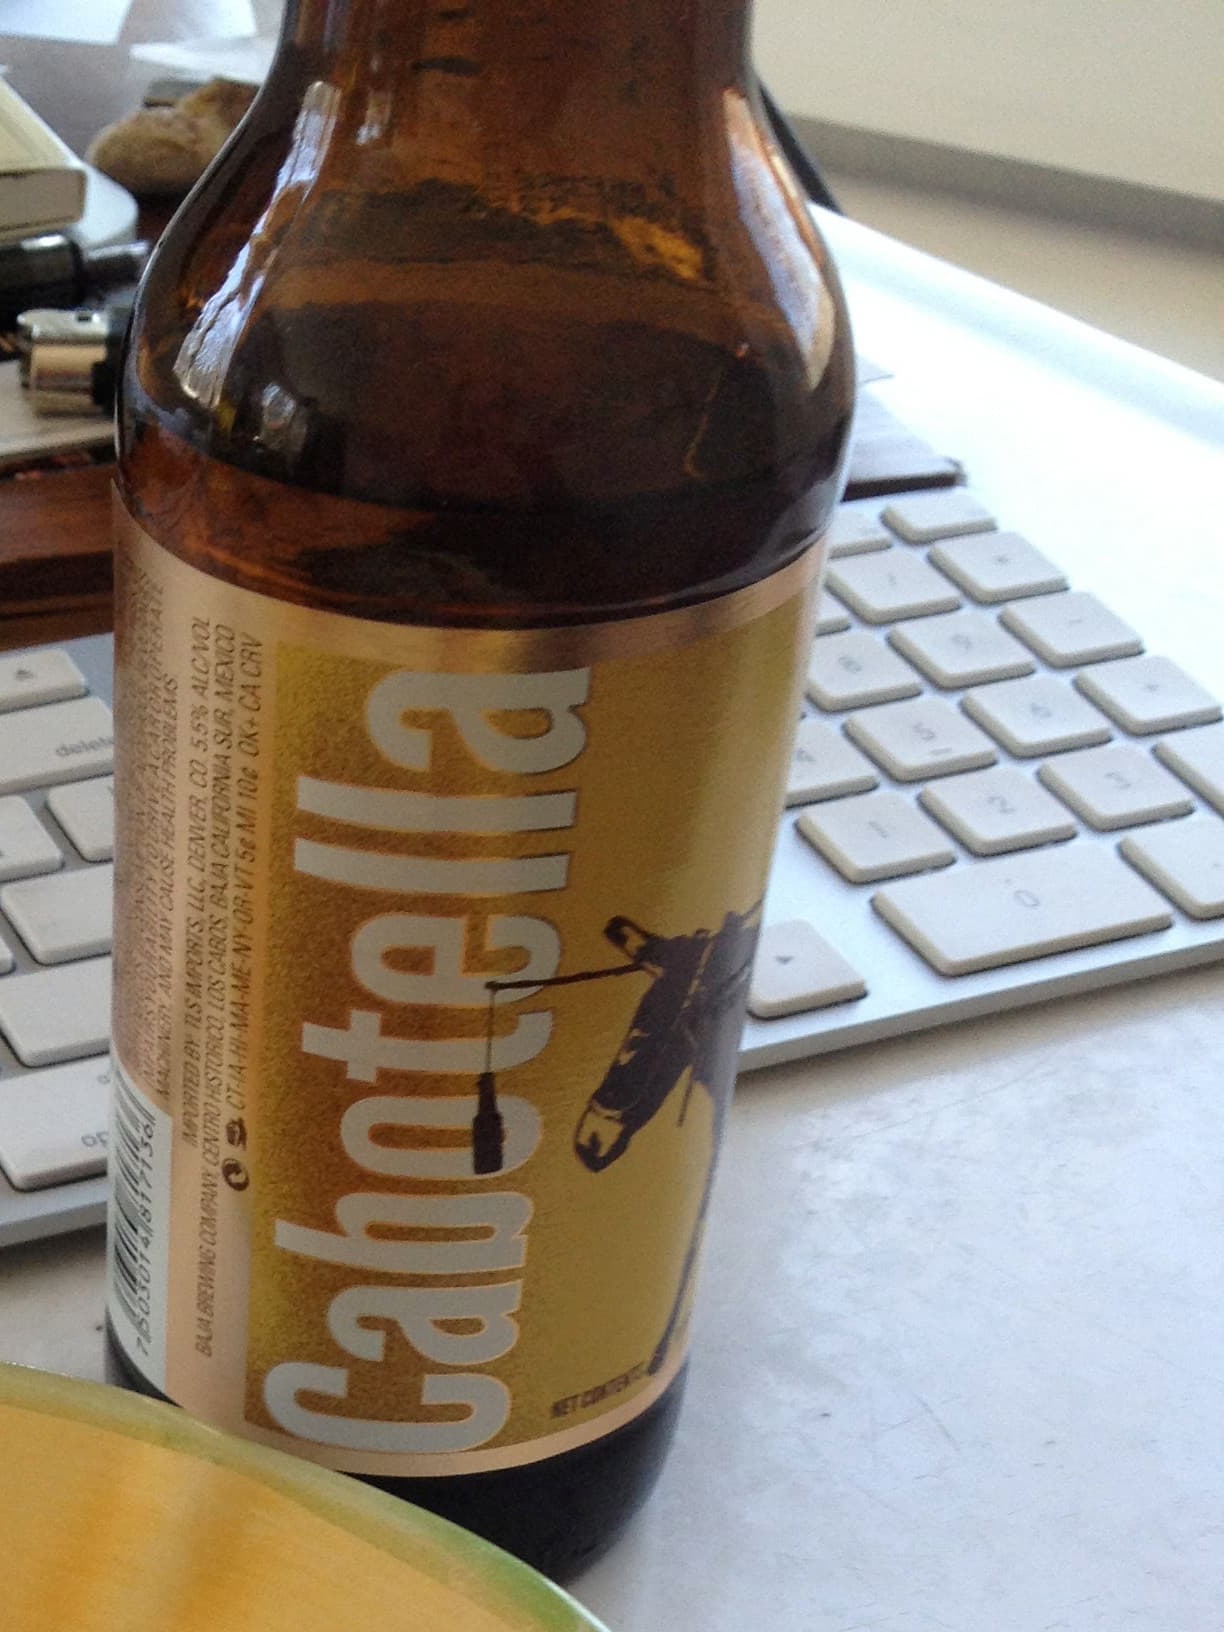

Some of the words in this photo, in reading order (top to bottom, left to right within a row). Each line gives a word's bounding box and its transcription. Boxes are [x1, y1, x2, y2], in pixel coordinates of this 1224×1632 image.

[190, 616, 211, 699] ALC/VOL
[213, 622, 235, 702] MEXICO
[239, 631, 263, 678] CRV
[239, 683, 262, 712] CA
[190, 703, 210, 751] 5.5%
[911, 722, 937, 742] 5
[159, 779, 176, 854] HEALTH
[210, 752, 231, 859] CALIFORNIA
[235, 805, 256, 833] MI
[986, 795, 1016, 815] 2
[159, 856, 175, 912] CAUSE
[209, 861, 228, 909] BAJA
[205, 974, 225, 1010] LOS
[262, 665, 592, 1454] Cabotella
[182, 1059, 200, 1146] IMPORTED
[202, 1101, 221, 1166] CENTRO
[196, 1245, 216, 1317] BREWING
